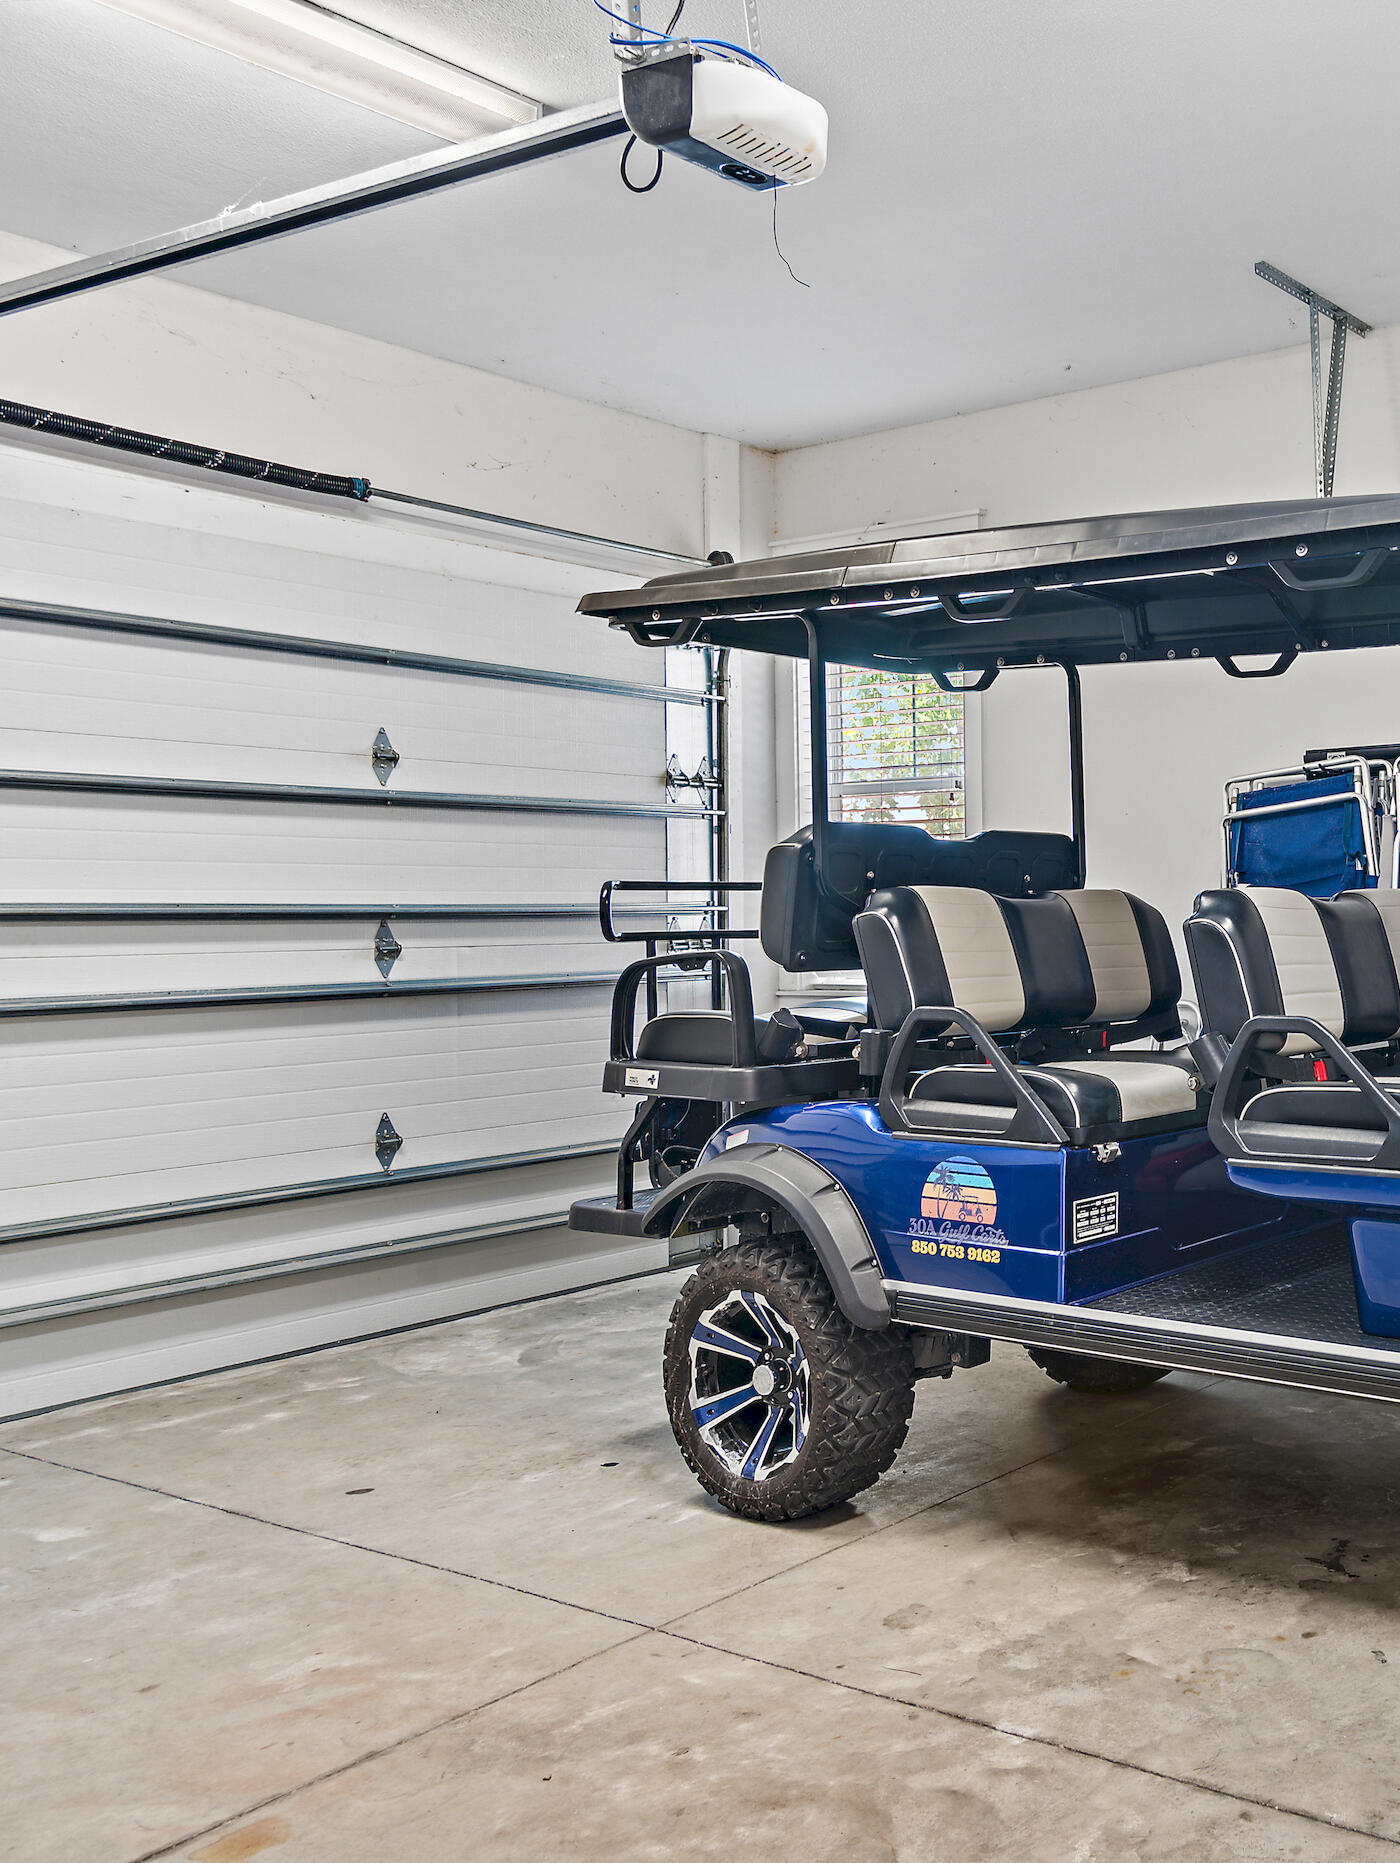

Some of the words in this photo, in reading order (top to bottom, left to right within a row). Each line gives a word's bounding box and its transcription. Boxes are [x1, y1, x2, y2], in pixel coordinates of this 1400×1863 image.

[909, 1218, 937, 1236] 30A
[938, 1221, 971, 1245] Gulf
[971, 1225, 1006, 1245] Carts
[911, 1239, 937, 1256] 850
[939, 1243, 965, 1259] 753
[967, 1247, 1001, 1263] 9162
